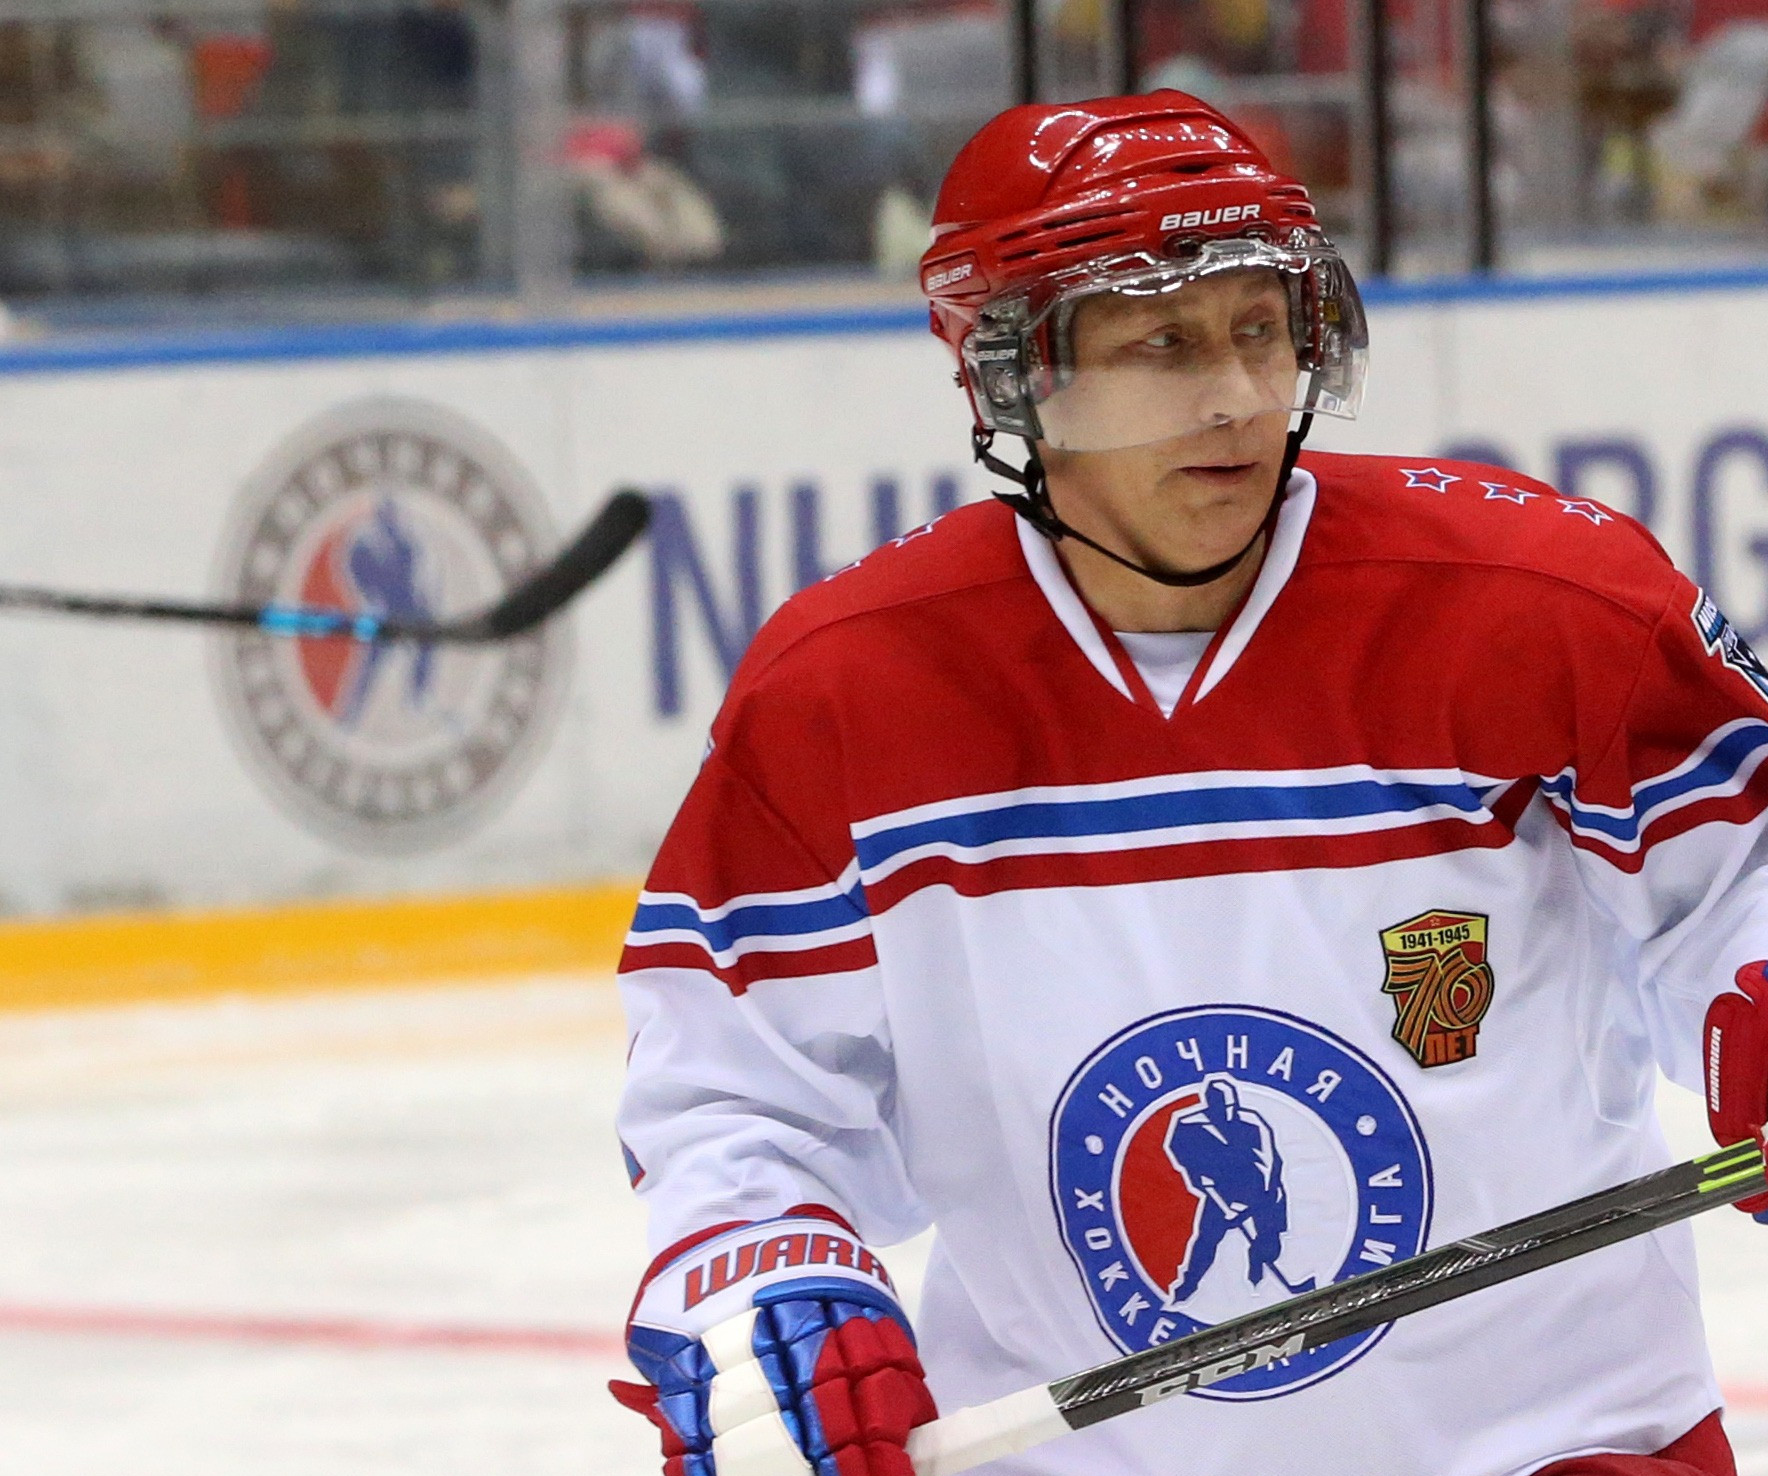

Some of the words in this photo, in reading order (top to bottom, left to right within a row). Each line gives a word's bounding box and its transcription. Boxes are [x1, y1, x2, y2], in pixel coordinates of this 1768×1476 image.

[1159, 203, 1261, 231] BAUER
[1400, 924, 1471, 950] 1941-1945
[1383, 947, 1494, 1061] 70
[1098, 1034, 1343, 1118] НОЧНАЯ
[1350, 1163, 1404, 1278] ИГА
[683, 1233, 899, 1312] WARR
[1135, 1332, 1307, 1406] CCM
